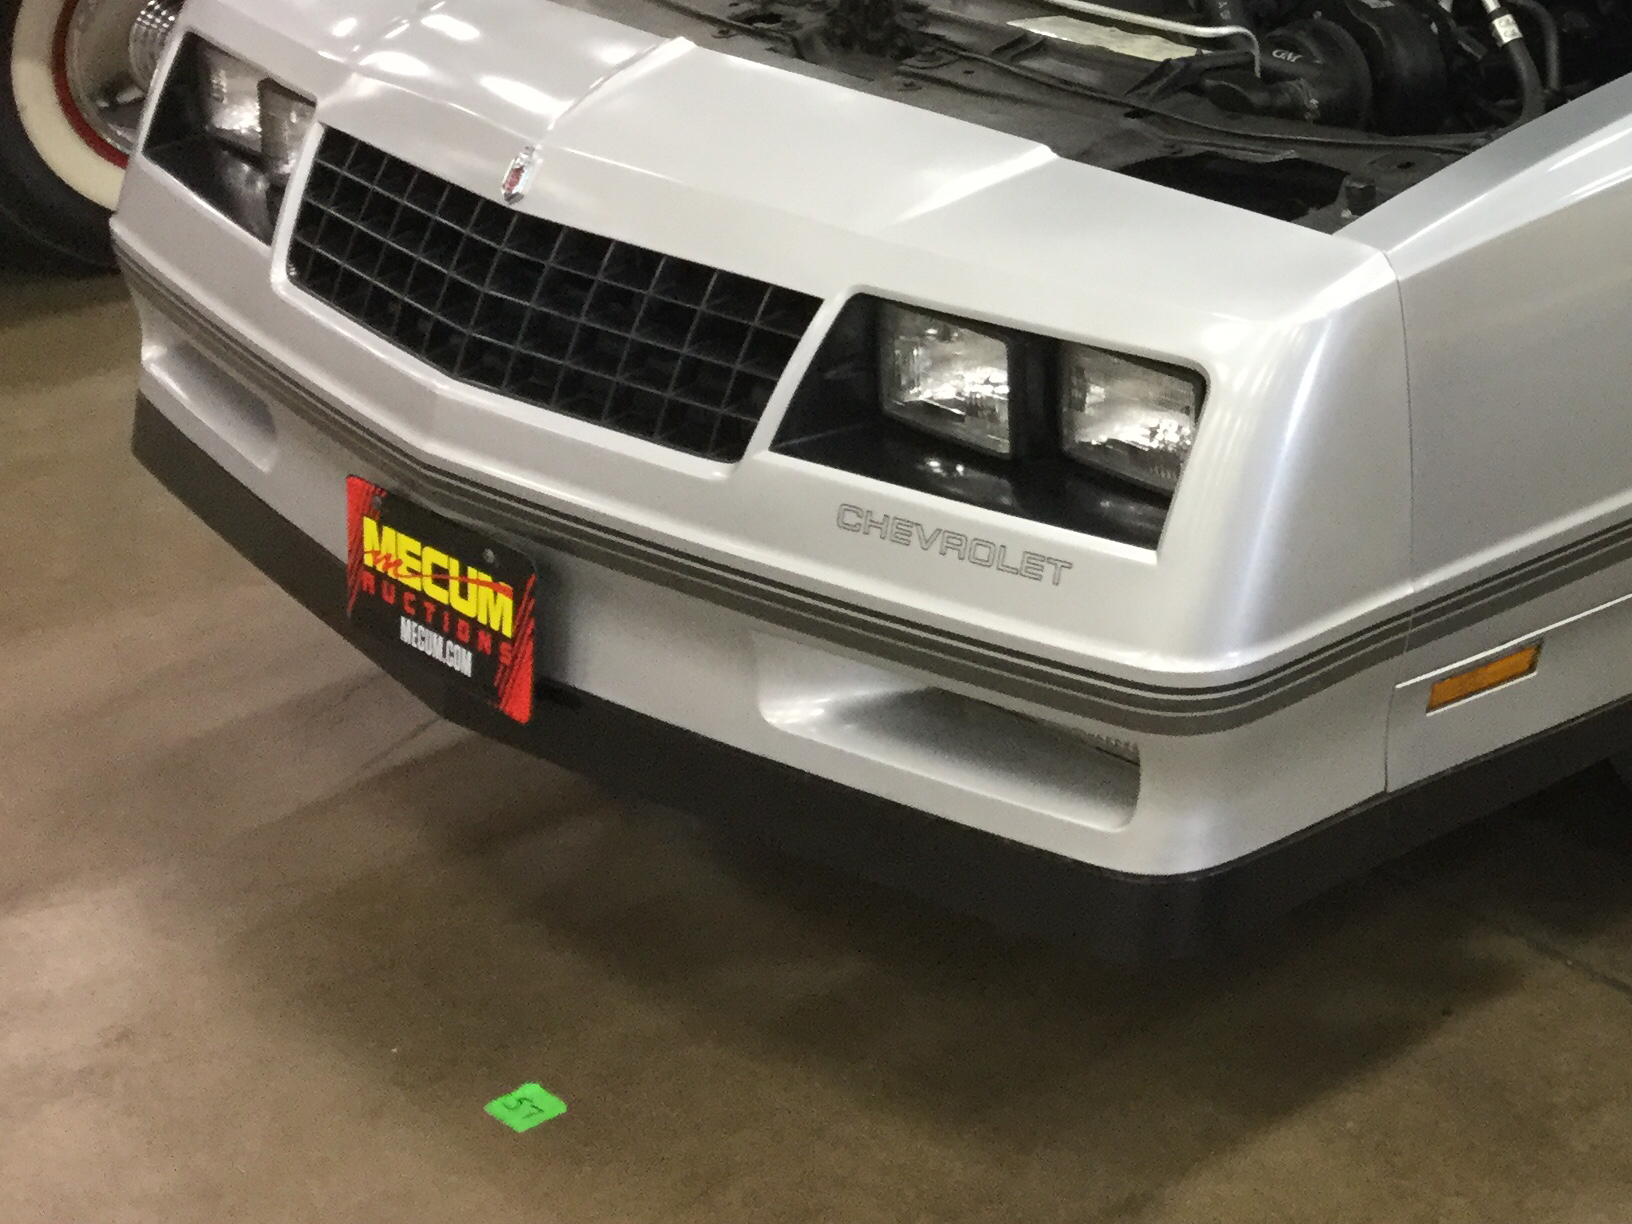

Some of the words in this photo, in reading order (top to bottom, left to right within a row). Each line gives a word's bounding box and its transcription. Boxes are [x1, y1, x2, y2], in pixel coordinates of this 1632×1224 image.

[362, 515, 514, 639] MECUM
[836, 503, 1074, 586] CHEVROLET
[361, 571, 514, 666] AUCTIONS
[400, 615, 473, 678] MECUM.COM
